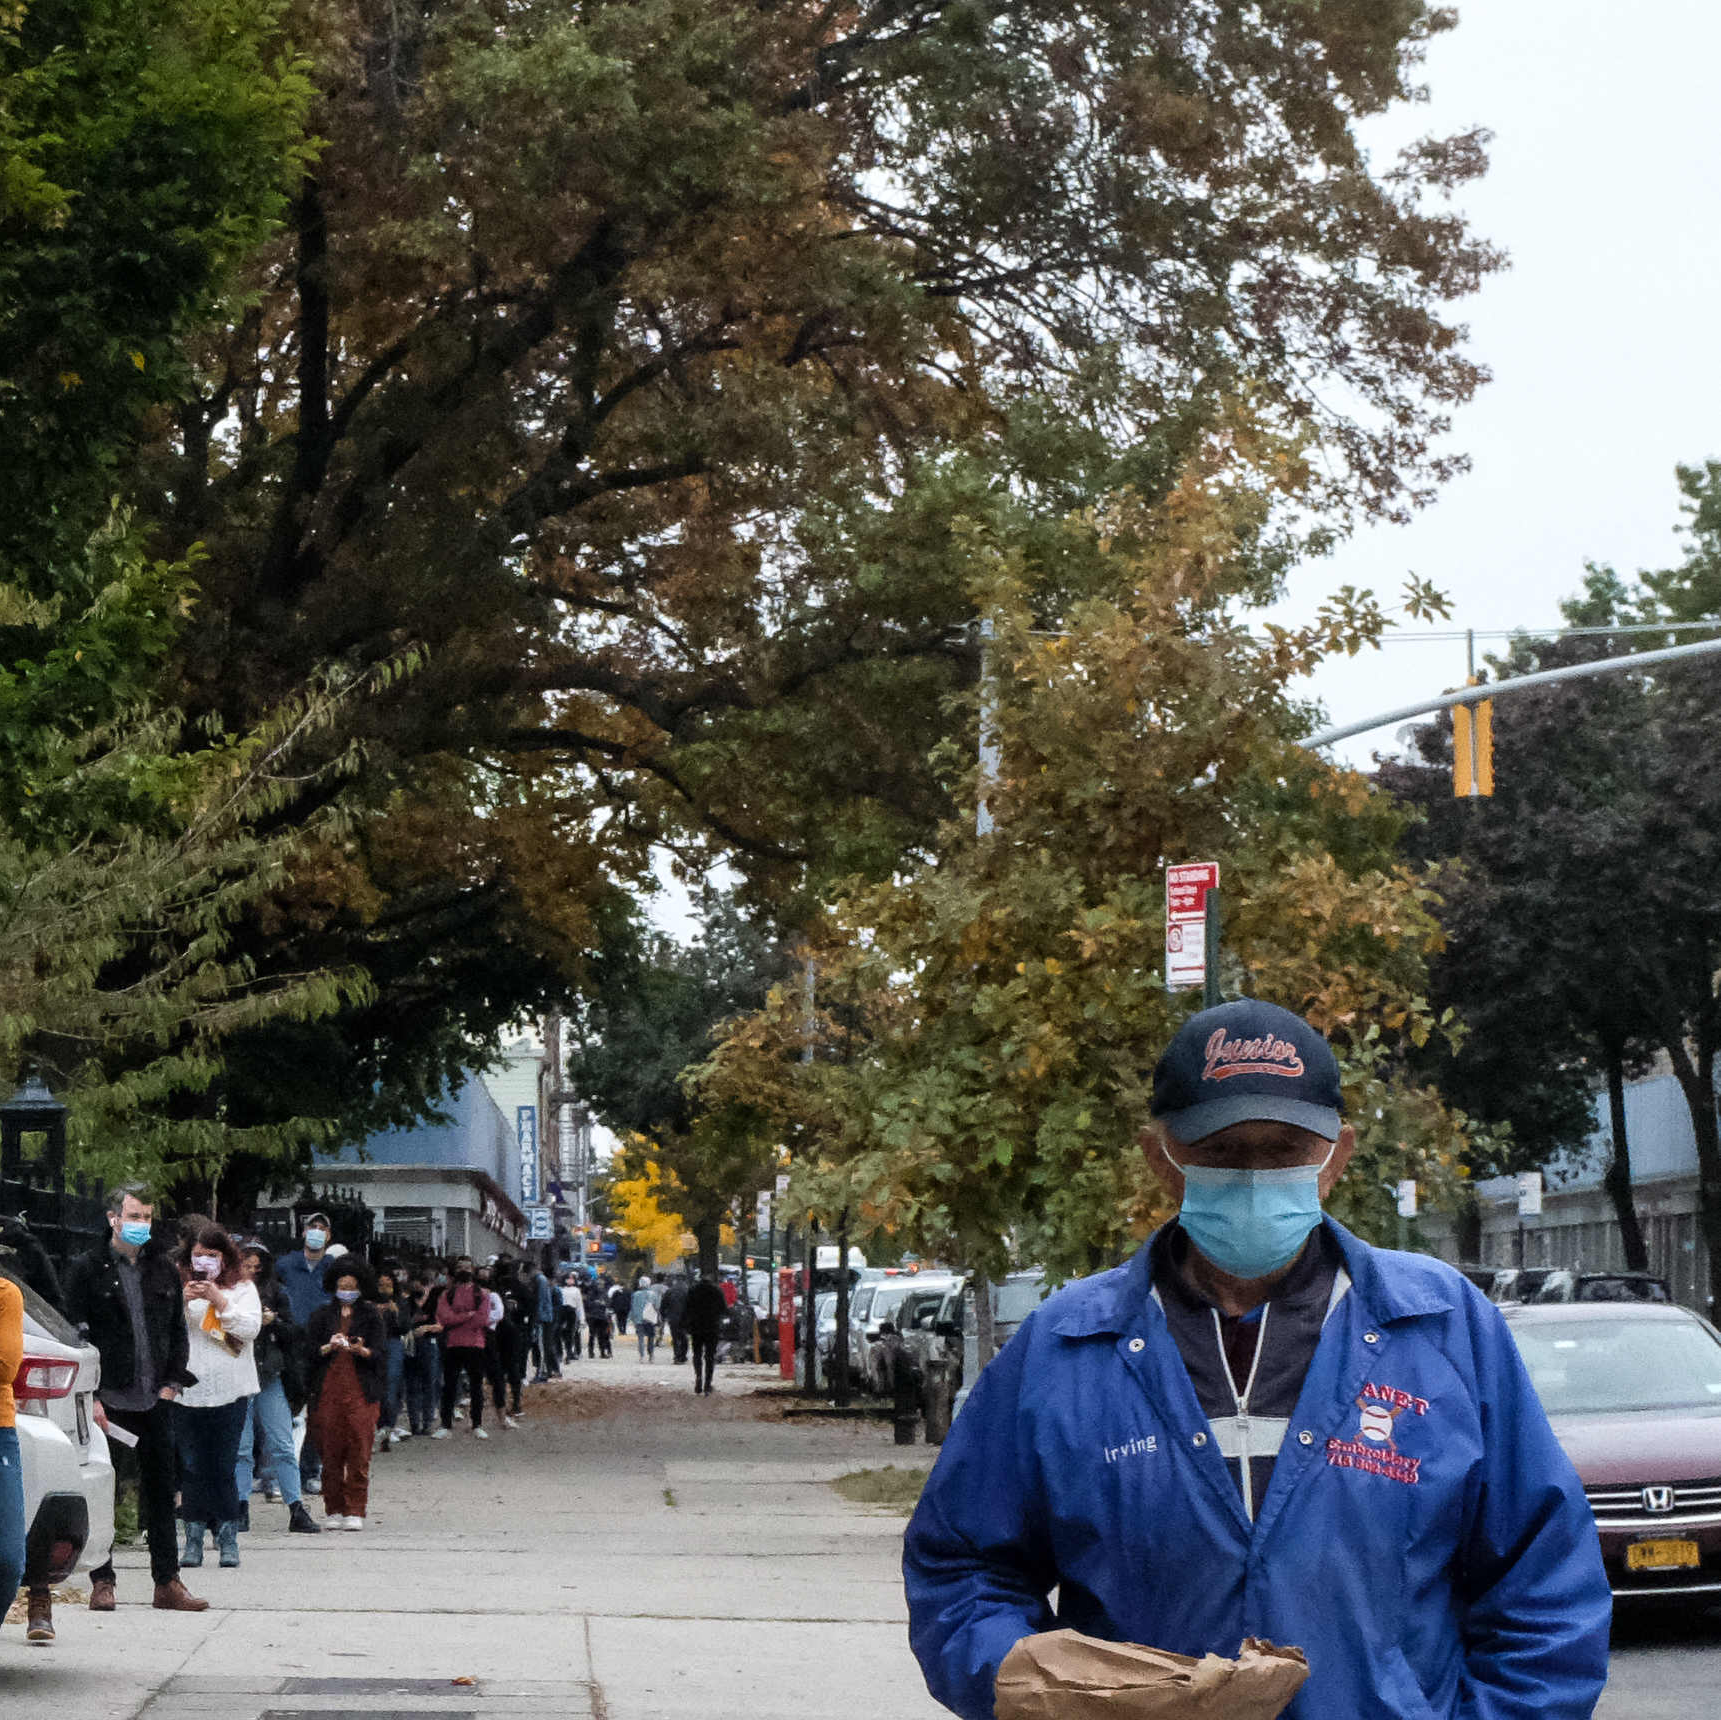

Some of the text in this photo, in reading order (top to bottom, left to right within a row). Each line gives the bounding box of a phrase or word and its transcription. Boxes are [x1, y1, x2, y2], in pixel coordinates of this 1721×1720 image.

[1202, 1028, 1301, 1081] Junior
[521, 1109, 534, 1198] PHARMACY
[1360, 1382, 1430, 1416] ANET
[1104, 1435, 1158, 1464] Irving
